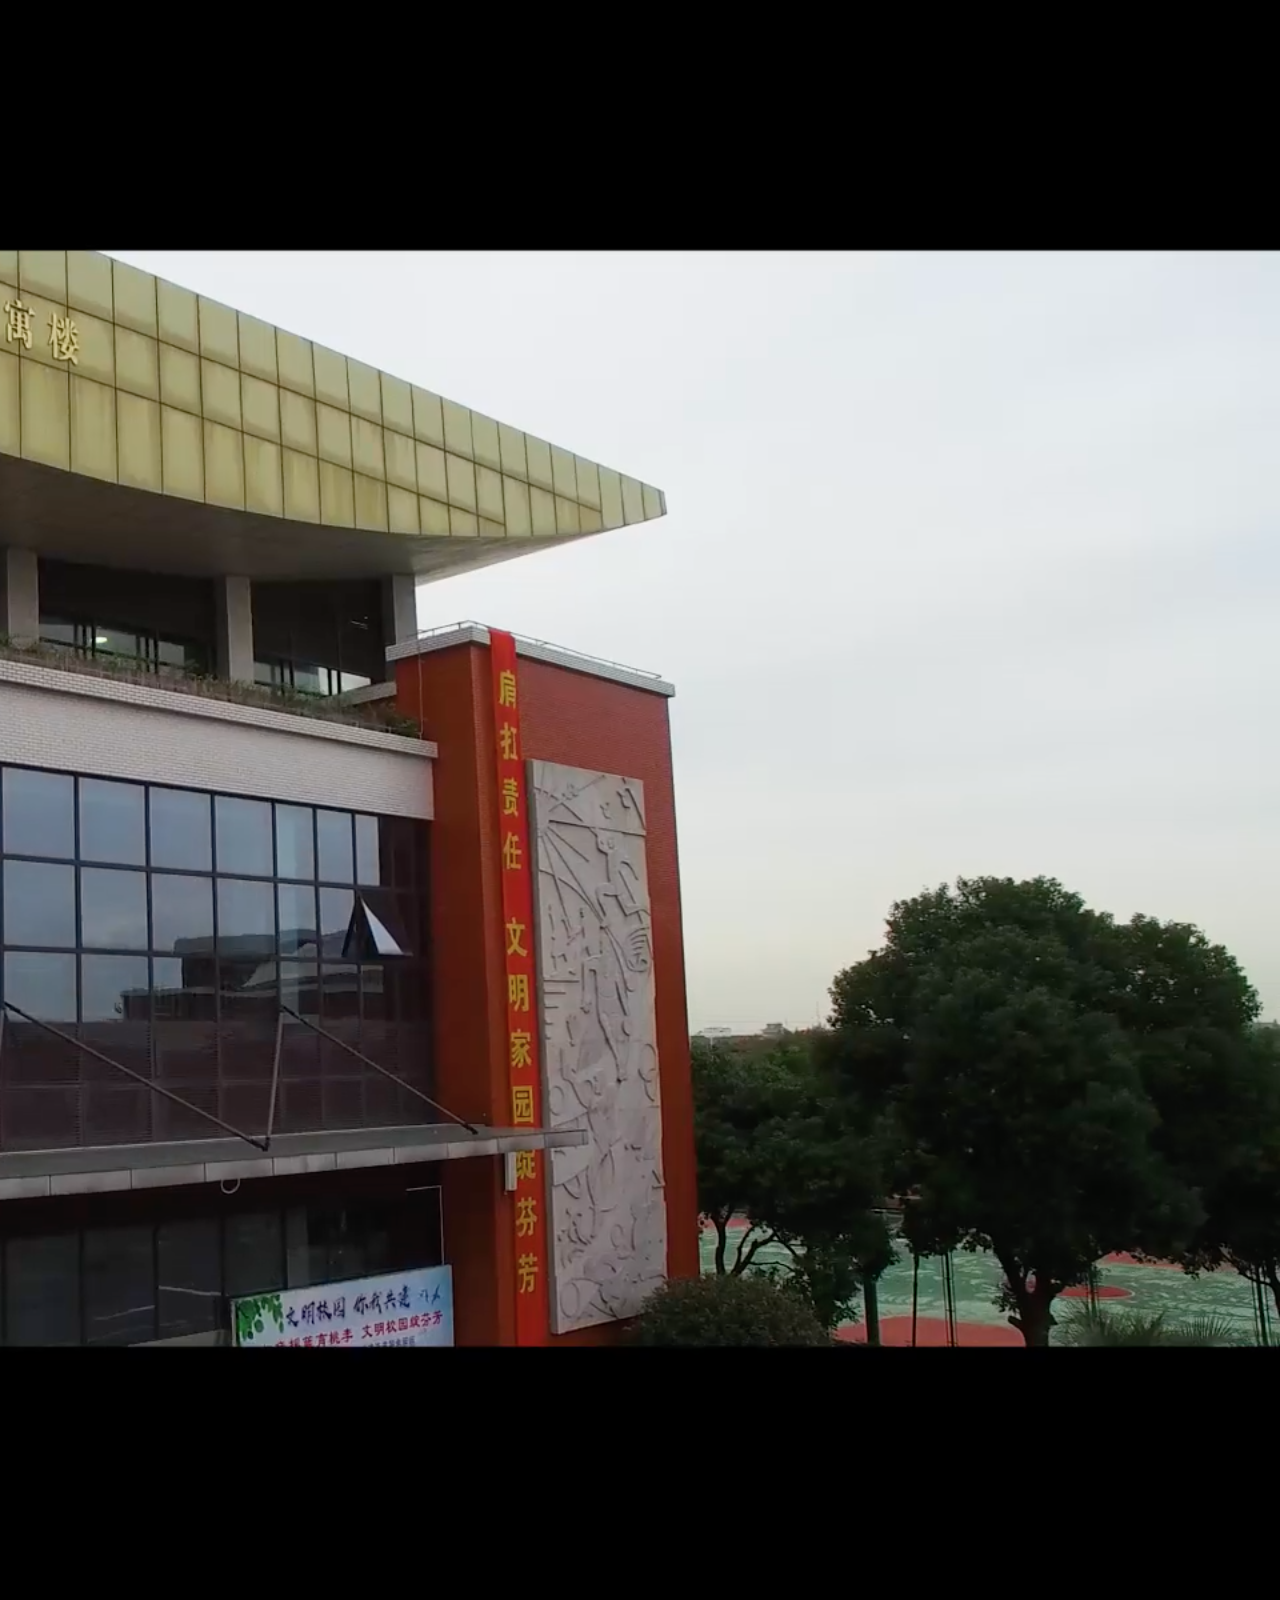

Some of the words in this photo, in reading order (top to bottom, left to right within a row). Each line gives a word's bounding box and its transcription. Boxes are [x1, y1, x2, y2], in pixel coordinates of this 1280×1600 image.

[498, 669, 522, 870] 肩扛责任
[285, 1297, 346, 1328] 文明校园
[353, 1285, 412, 1315] 你我共建
